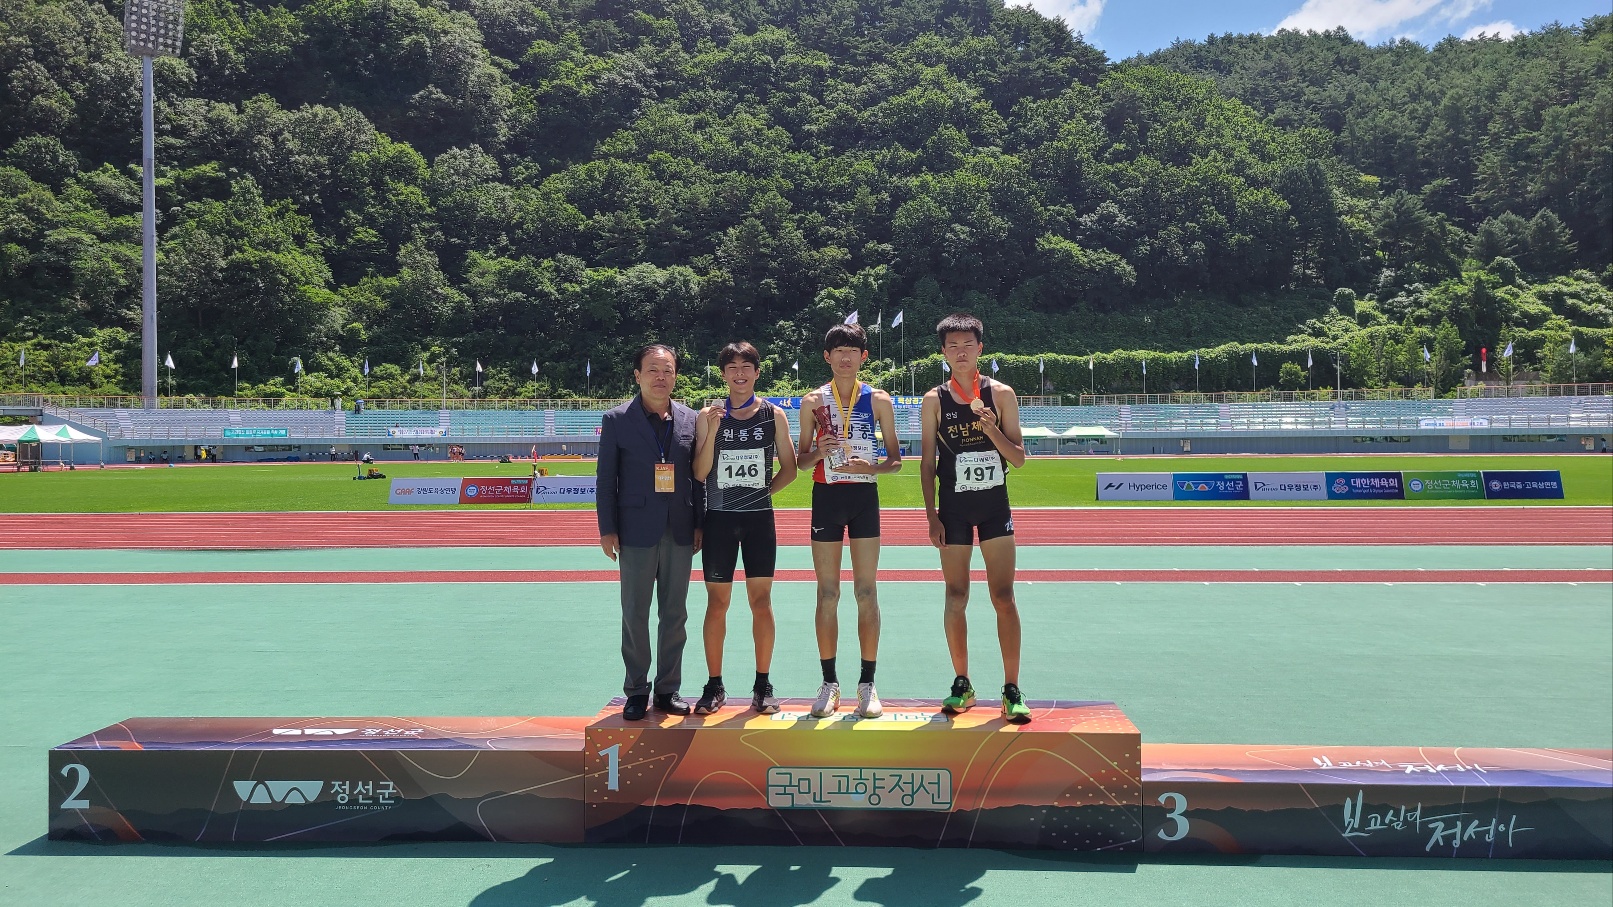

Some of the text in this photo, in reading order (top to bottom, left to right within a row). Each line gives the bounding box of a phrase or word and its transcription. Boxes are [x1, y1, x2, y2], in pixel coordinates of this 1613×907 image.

[723, 427, 764, 442] 원통중
[724, 463, 759, 479] 146
[963, 466, 996, 482] 197
[479, 484, 529, 495] 정선군체육회
[1127, 481, 1169, 492] Hyperice
[1215, 480, 1244, 491] 정선군
[1279, 482, 1322, 492] 다우정보(주)
[1350, 477, 1399, 488] 대한체육회
[1424, 479, 1479, 490] 정선군체육회
[598, 743, 619, 790] 1
[60, 763, 91, 809] 2
[330, 780, 397, 804] 정선군
[1157, 791, 1190, 841] 3
